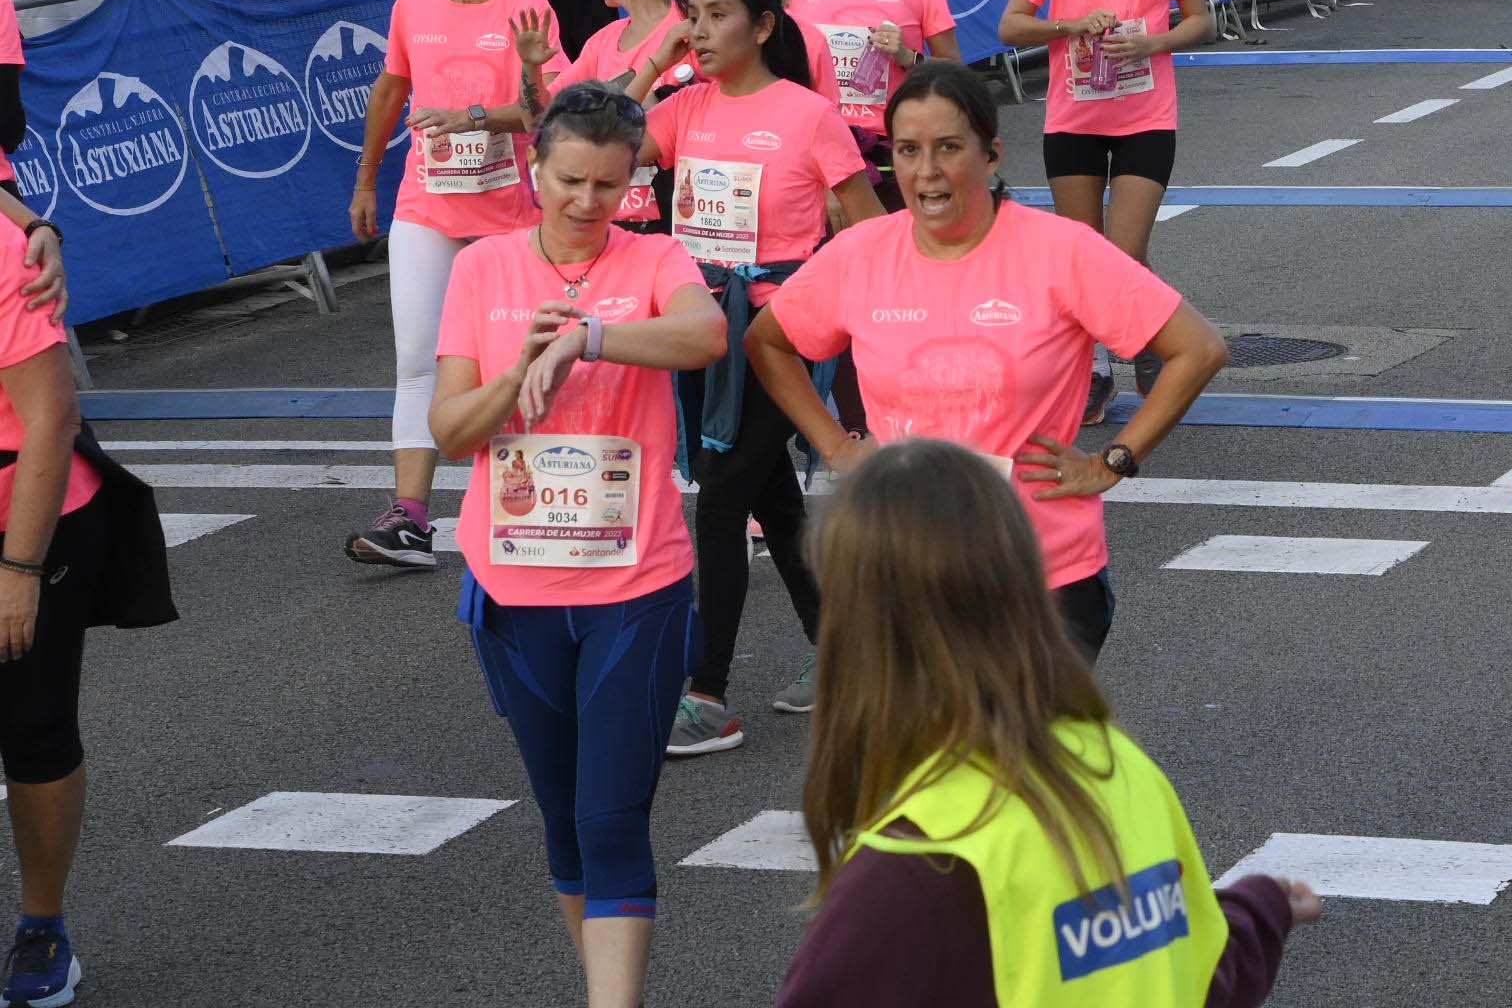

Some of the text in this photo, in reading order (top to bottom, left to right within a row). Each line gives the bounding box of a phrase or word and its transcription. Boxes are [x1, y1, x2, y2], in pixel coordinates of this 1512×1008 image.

[213, 90, 252, 105] CENTRAL
[841, 104, 875, 117] MA
[79, 121, 122, 141] CENTRAL
[201, 99, 306, 151] ASTURIANA
[455, 143, 485, 154] 016
[459, 158, 482, 166] 10115
[698, 198, 725, 214] 016
[701, 217, 722, 227] 18620
[722, 245, 751, 254] Santander
[872, 309, 928, 323] OYSHO
[538, 457, 591, 469] ASTURIANA
[541, 487, 588, 506] 016
[547, 512, 578, 523] 9034
[581, 547, 624, 557] Santander
